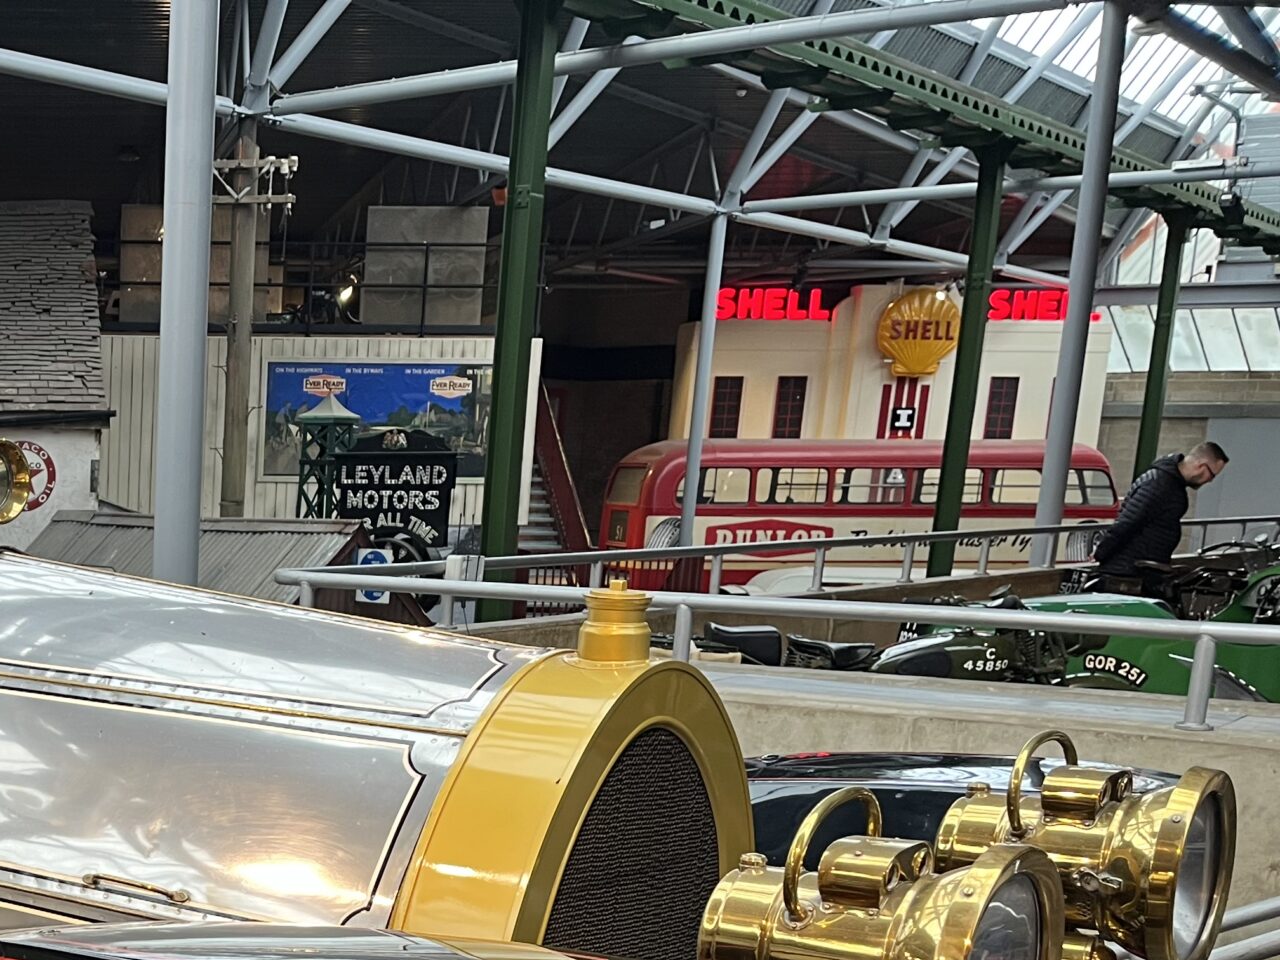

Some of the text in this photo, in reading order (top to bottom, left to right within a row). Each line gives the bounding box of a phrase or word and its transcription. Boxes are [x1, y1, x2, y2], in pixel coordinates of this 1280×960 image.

[716, 288, 830, 321] SHELL
[890, 319, 955, 341] SHELL
[341, 465, 447, 485] LEYLAND
[39, 481, 55, 502] OIL
[347, 490, 440, 510] MOTORS
[377, 512, 404, 528] ALL
[408, 515, 439, 544] TIME
[986, 648, 996, 660] C
[964, 659, 1008, 672] 45850
[1085, 655, 1146, 685] GOR 251
